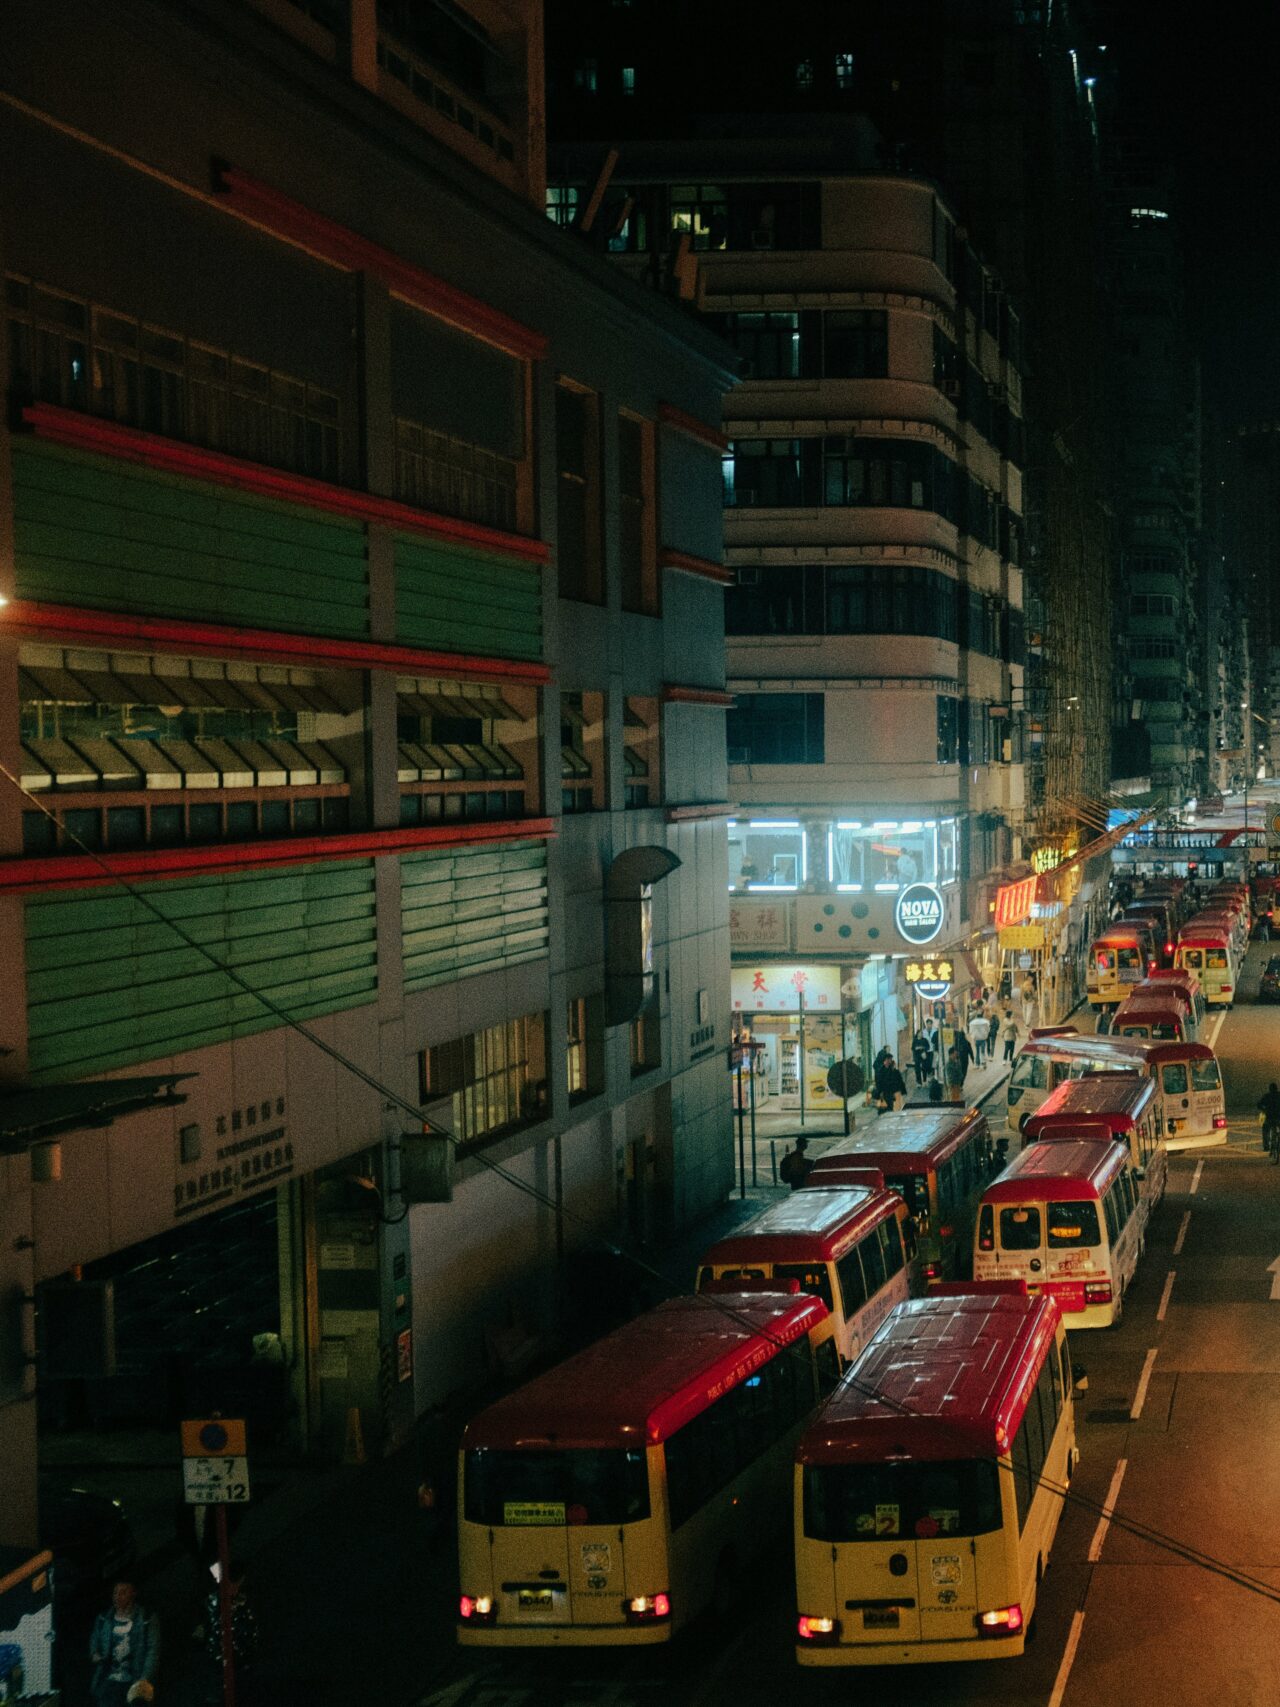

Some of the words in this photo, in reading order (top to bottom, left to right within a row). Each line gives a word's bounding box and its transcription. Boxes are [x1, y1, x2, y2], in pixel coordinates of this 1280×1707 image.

[901, 900, 939, 916] NOVA
[223, 1459, 235, 1475] 7
[227, 1484, 246, 1500] 12
[879, 1517, 895, 1537] 2
